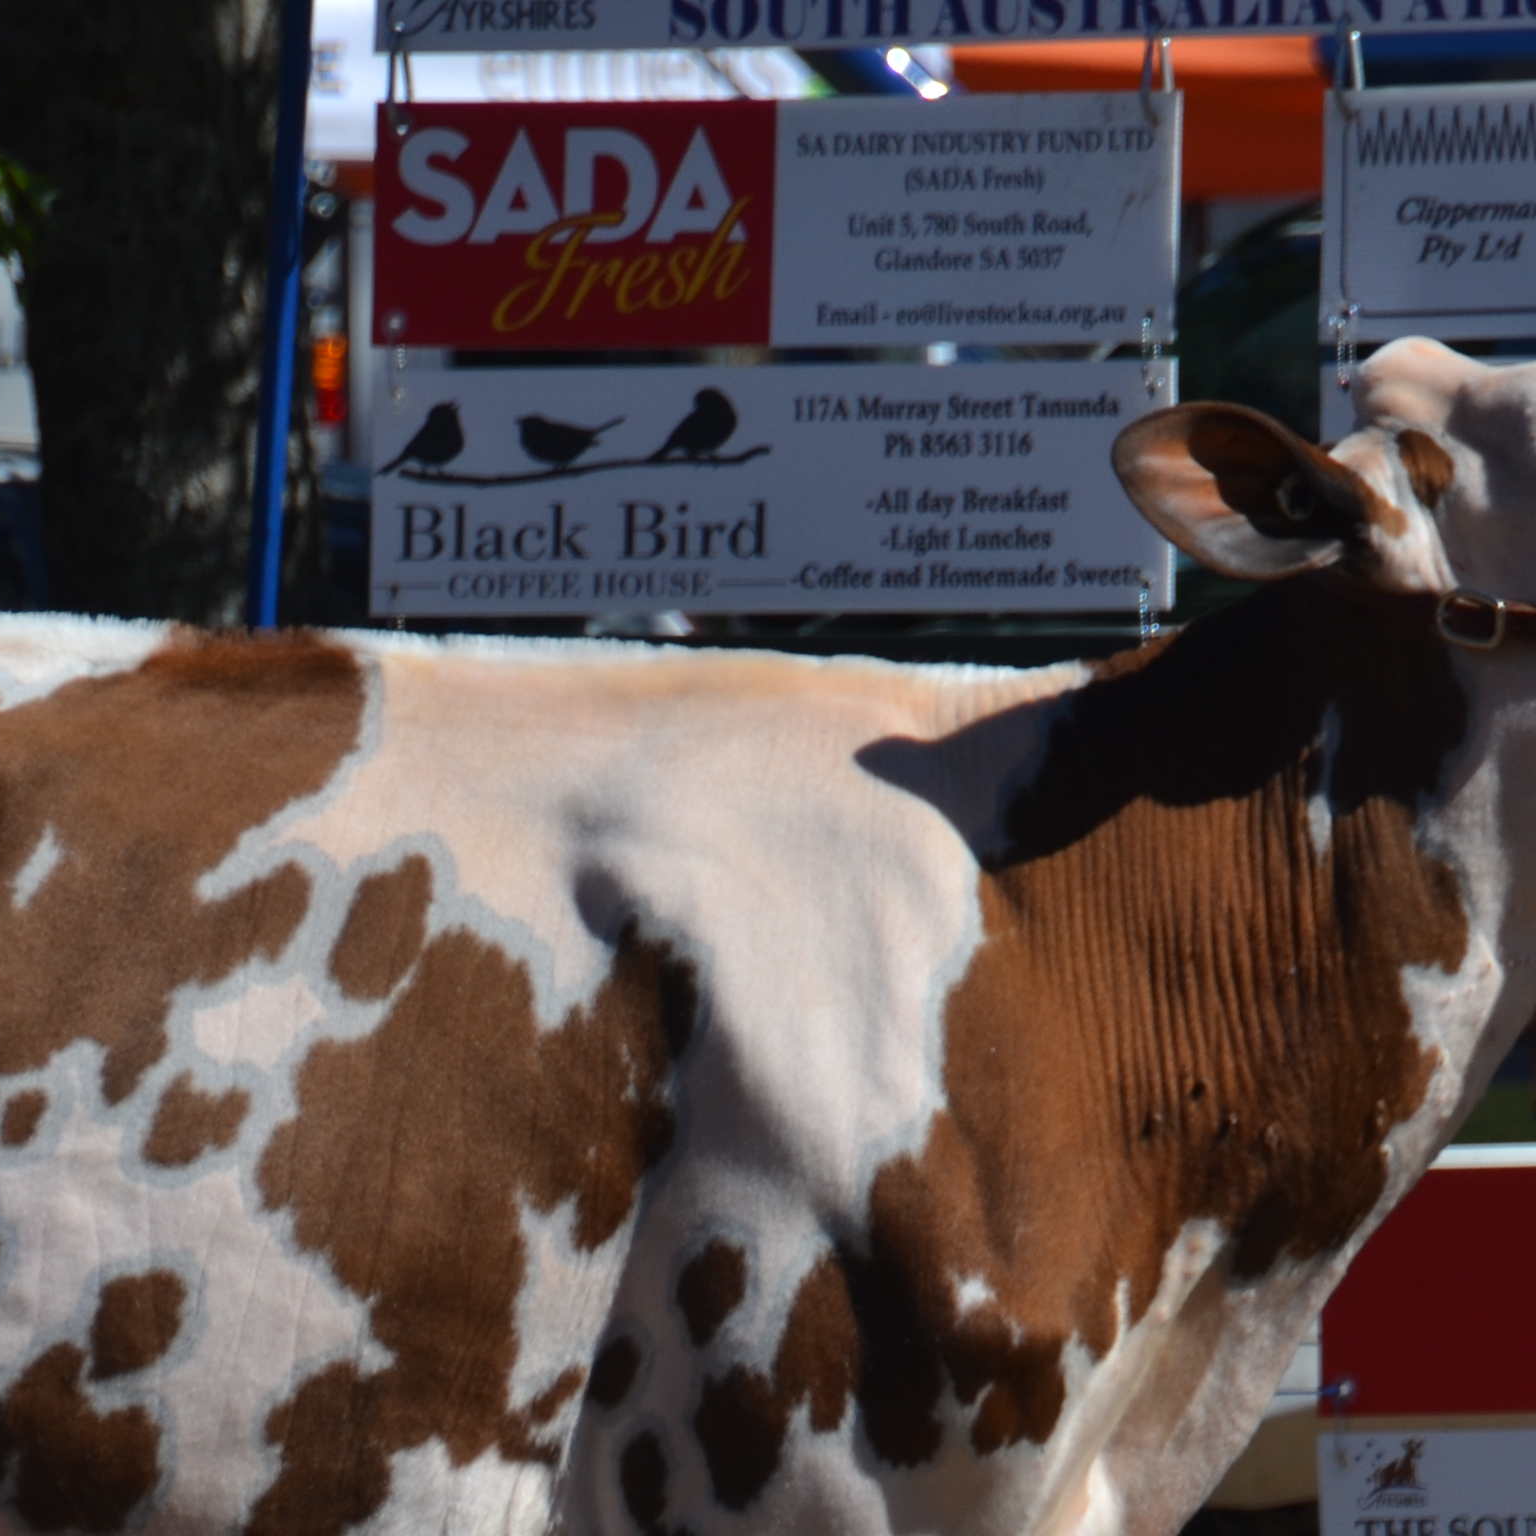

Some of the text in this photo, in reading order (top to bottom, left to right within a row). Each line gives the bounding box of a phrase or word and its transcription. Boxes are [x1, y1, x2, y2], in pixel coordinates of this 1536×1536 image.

[669, 0, 910, 42] SOUTH
[796, 128, 1155, 157] SA DAIRY INDUSTRY FUND LTD
[390, 125, 748, 246] SADA
[904, 167, 1045, 195] (SADA Fresh)
[848, 210, 1093, 240] Unit 5, 780 South Road,
[492, 193, 754, 333] Fresh
[874, 246, 1064, 271] Glandore SA 5037
[1416, 232, 1466, 268] Pty
[817, 303, 876, 326] Email
[794, 393, 1120, 426] 117A Murray Street Tanunda
[884, 431, 1033, 458] Ph 8563 3116
[916, 488, 955, 519] day
[962, 487, 1069, 513] Breakfast
[398, 500, 768, 562] Black Bird
[958, 525, 1052, 551] Lunches
[447, 569, 713, 599] COFFEE HOUSE
[881, 563, 921, 588] and
[928, 562, 1057, 588] Homemade
